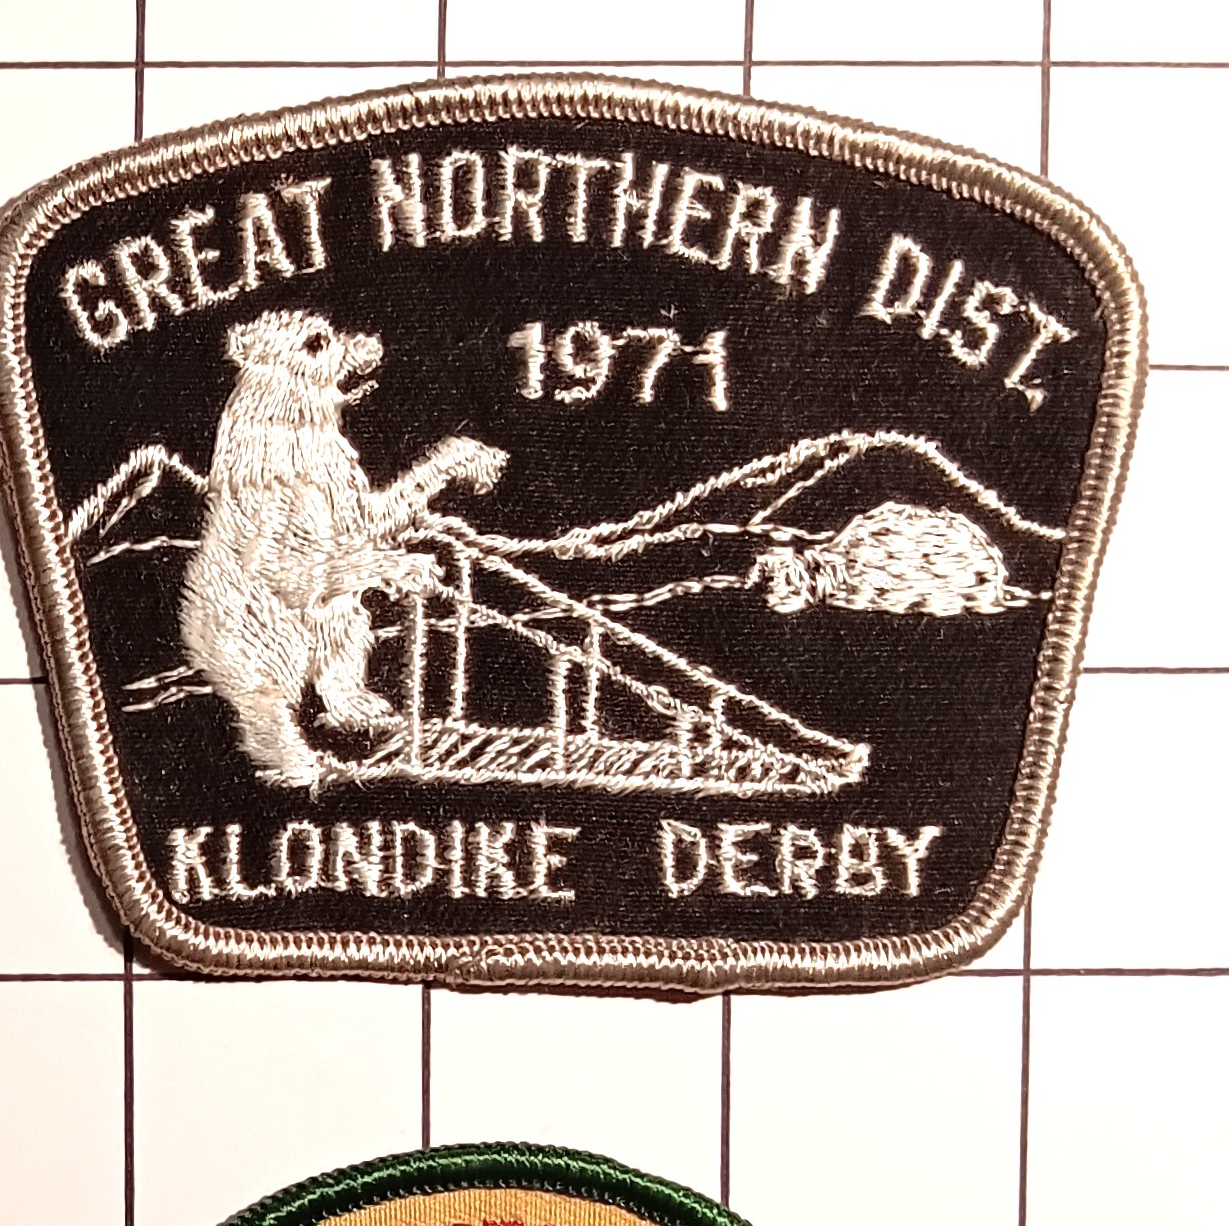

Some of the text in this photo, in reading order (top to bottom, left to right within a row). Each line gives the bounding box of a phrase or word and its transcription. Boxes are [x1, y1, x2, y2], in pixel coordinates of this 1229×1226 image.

[58, 174, 333, 355] GREAT
[369, 148, 841, 295] NORTHERN
[506, 322, 731, 411] 1971
[169, 820, 948, 906] KLONDIKE DERBY
